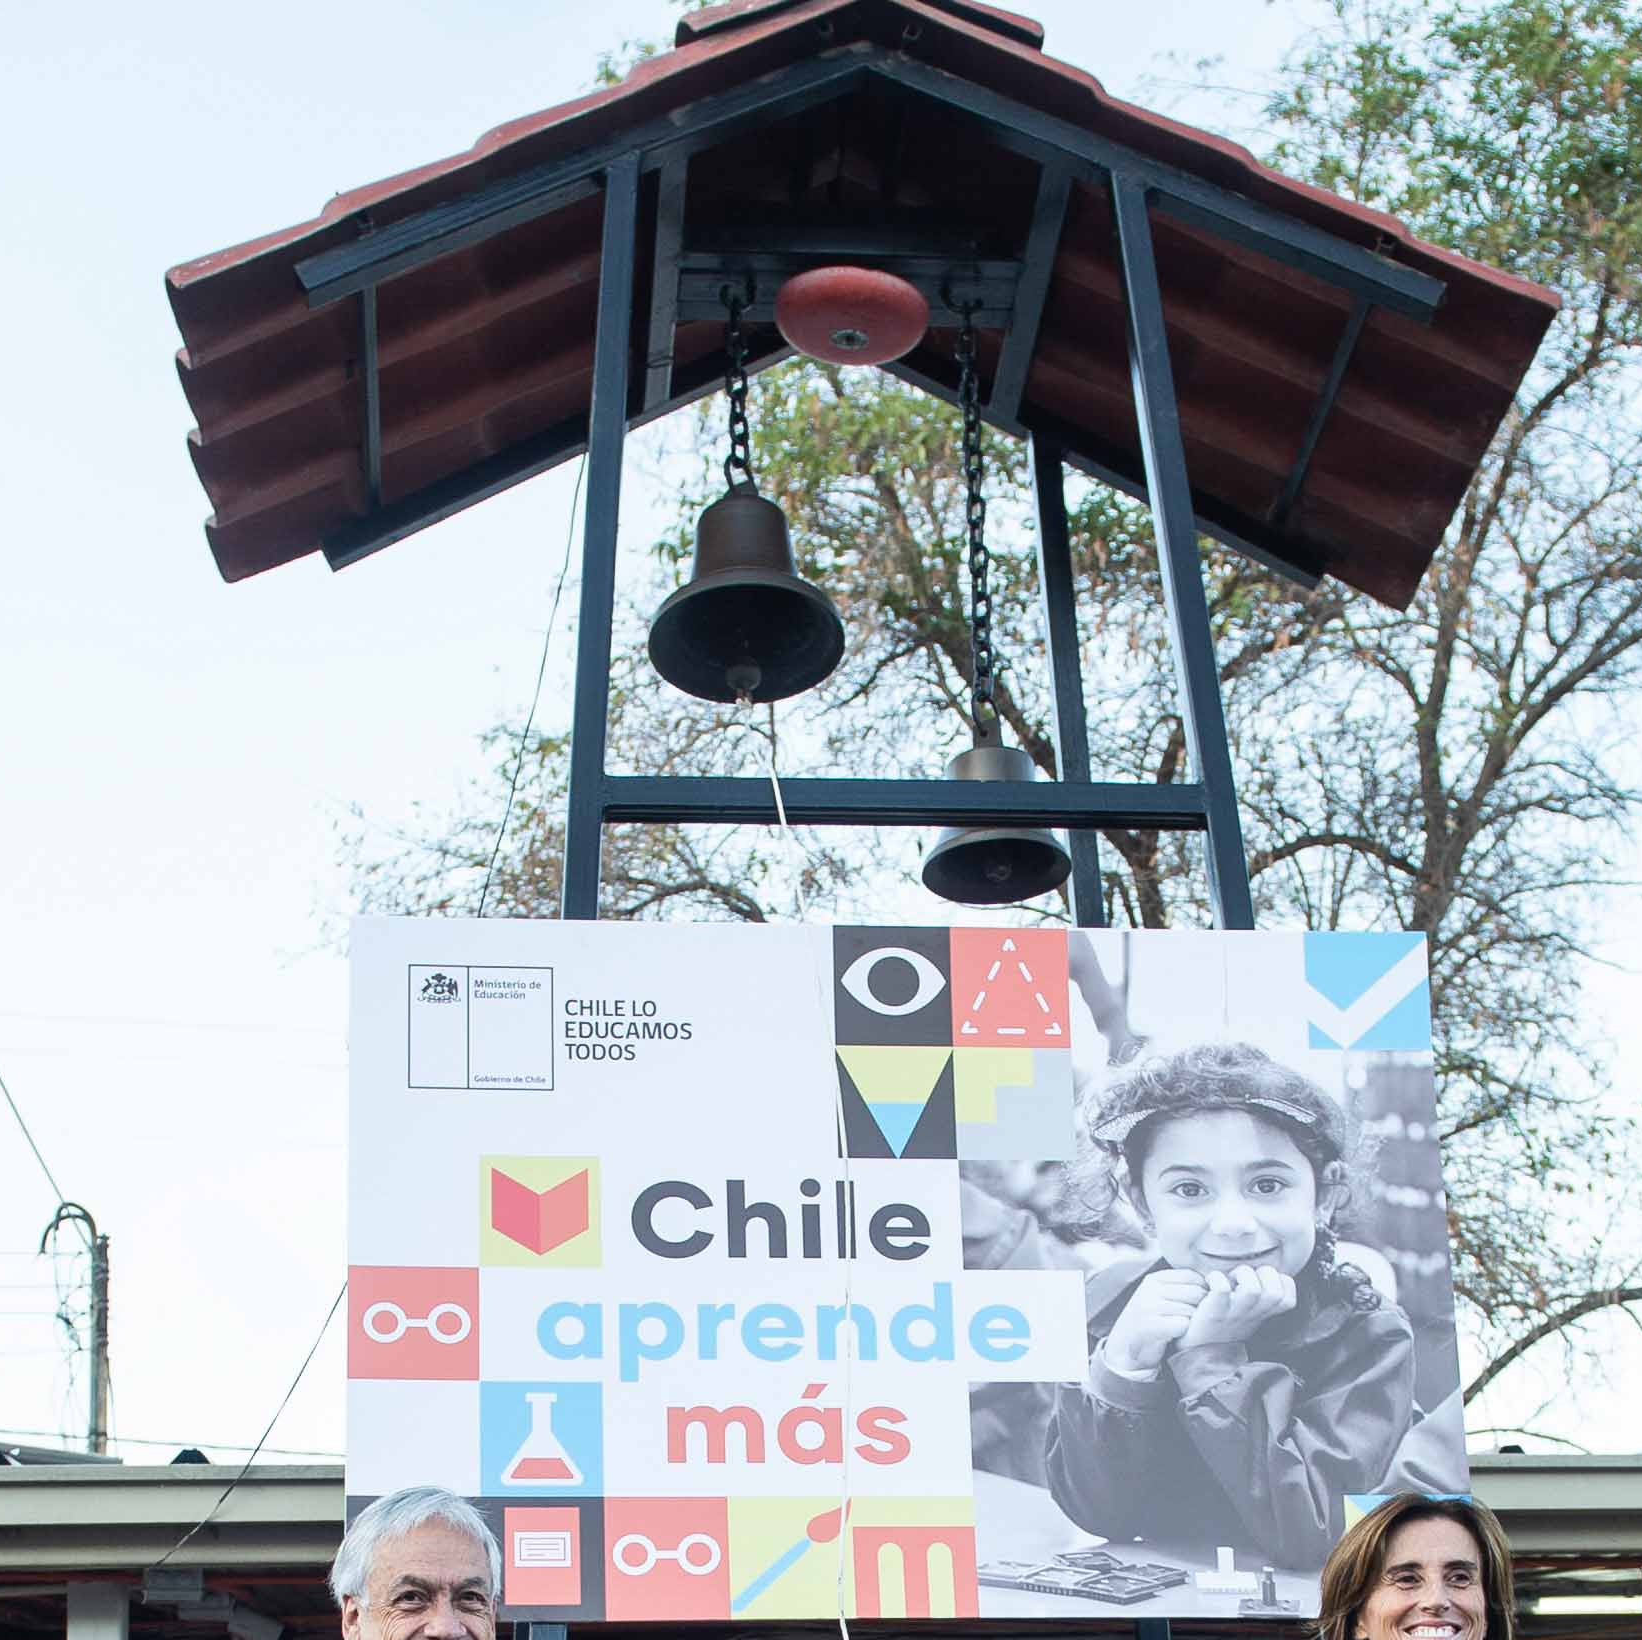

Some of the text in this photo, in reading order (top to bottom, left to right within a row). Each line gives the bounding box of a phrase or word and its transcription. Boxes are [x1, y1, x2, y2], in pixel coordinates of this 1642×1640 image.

[474, 979, 541, 990] Ministerio de
[474, 989, 525, 1000] Educación
[564, 999, 657, 1017] CHILE LO
[564, 1021, 692, 1040] EDUCAMOS
[564, 1043, 636, 1061] TODOS
[631, 1178, 931, 1261] Chile
[536, 1281, 1030, 1383] aprende
[667, 1384, 911, 1464] más
